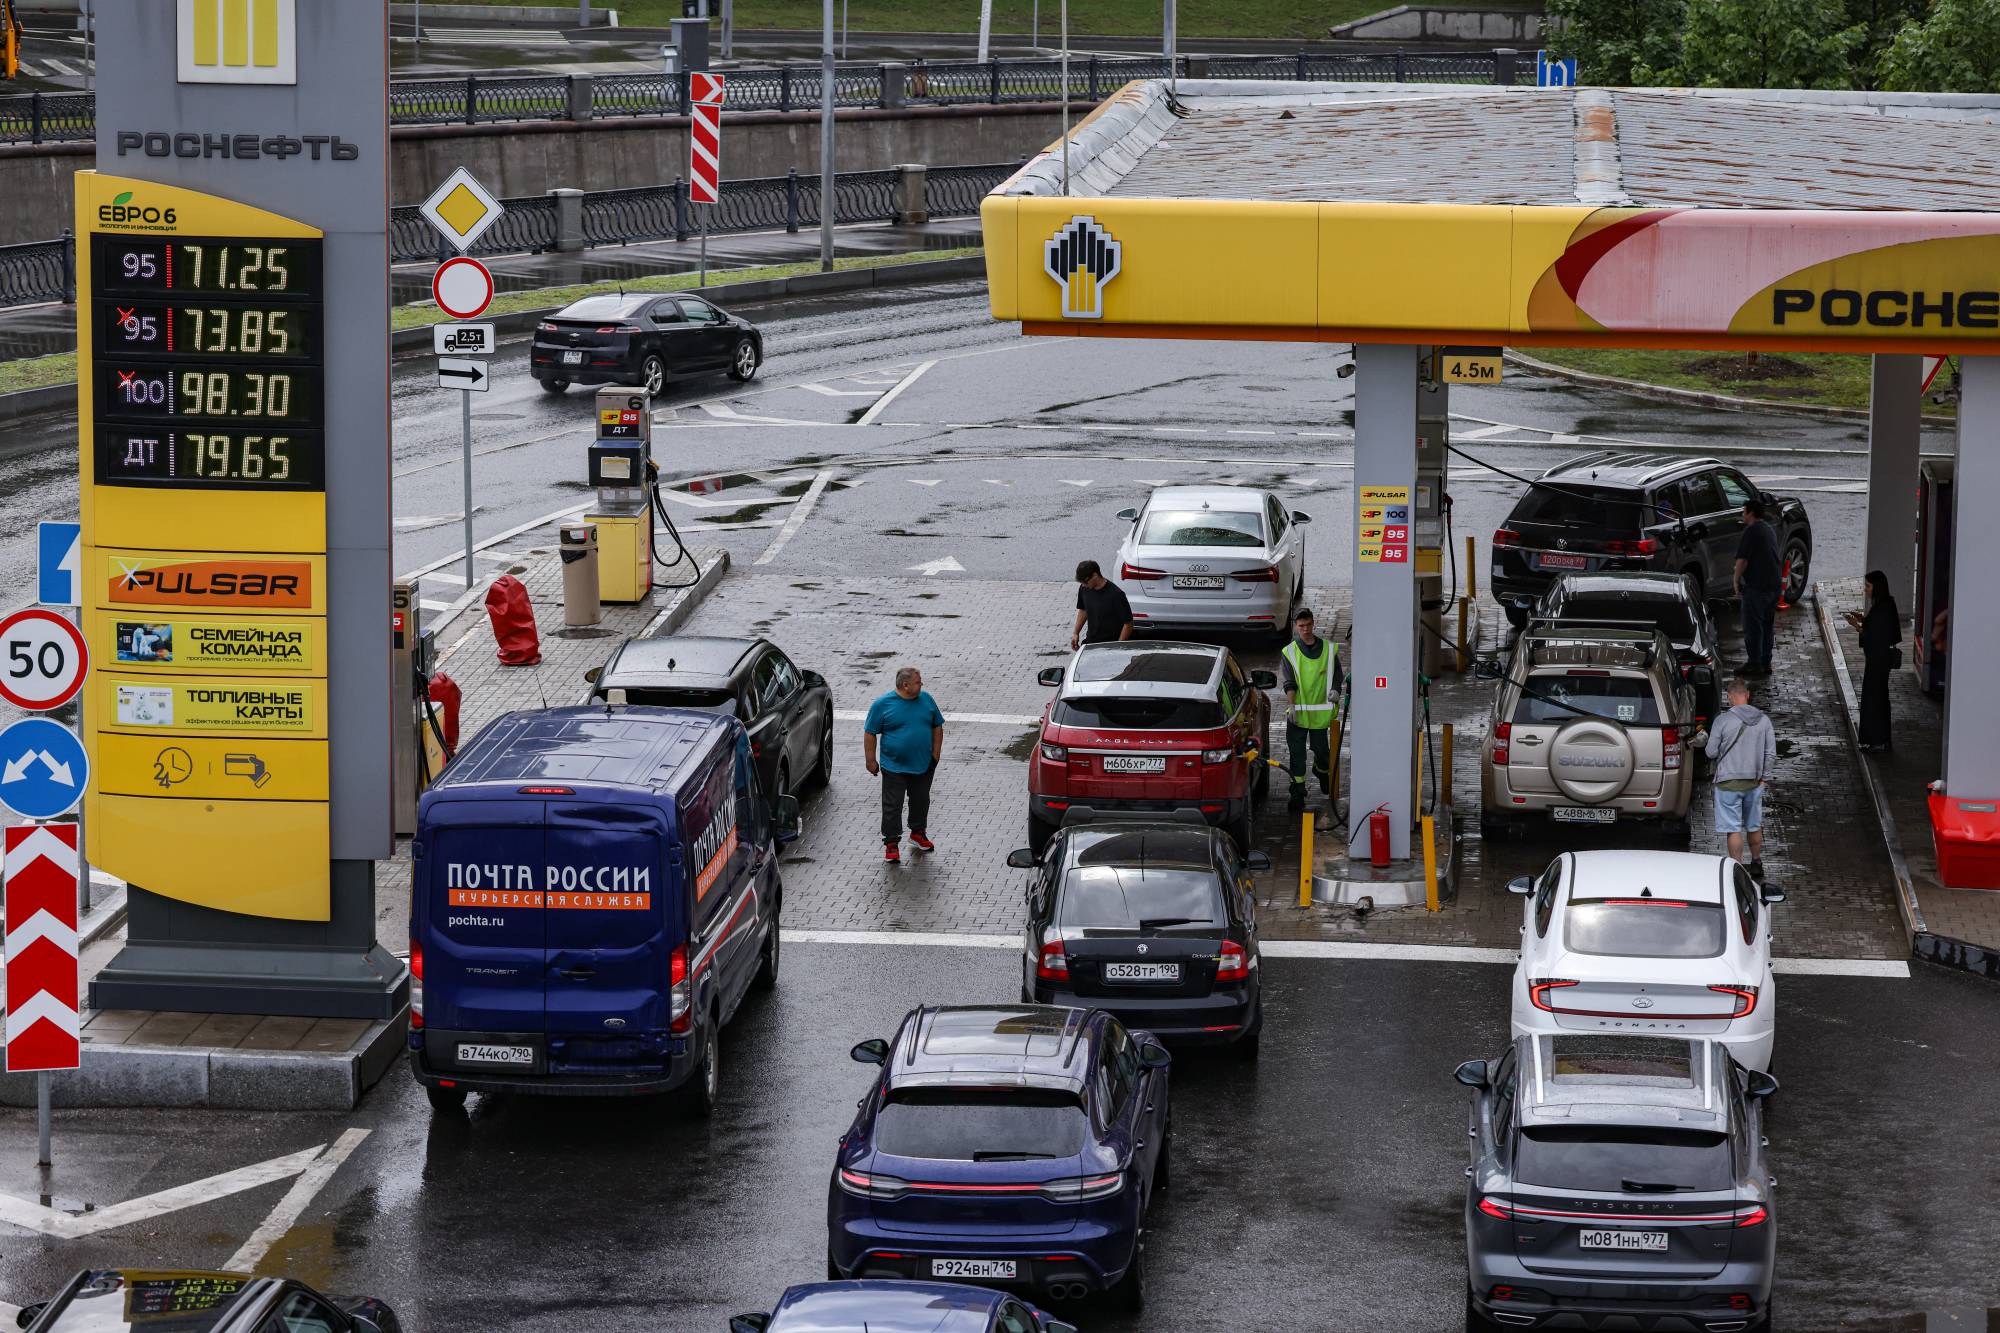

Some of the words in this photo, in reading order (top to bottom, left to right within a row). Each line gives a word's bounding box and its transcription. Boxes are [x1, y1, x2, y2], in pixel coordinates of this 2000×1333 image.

[117, 131, 359, 161] РОСНЕФТЬ
[98, 205, 161, 224] ЕВРО
[163, 208, 177, 224] 6
[123, 252, 156, 278] 95
[184, 245, 288, 290] 71.25
[1773, 289, 2000, 328] РОСНЕ
[124, 315, 157, 341] 95
[184, 309, 288, 353] 73.85
[120, 379, 165, 404] 100
[182, 372, 290, 417] 98.30
[628, 396, 643, 411] 6
[622, 413, 637, 421] 95
[612, 426, 628, 434] ДТ
[124, 438, 159, 467] ДТ
[186, 434, 290, 479] 79.65
[1386, 510, 1406, 519] 100
[1387, 530, 1405, 538] 95
[1384, 549, 1402, 558] 95
[1209, 576, 1222, 584] 790
[190, 628, 302, 643] СЕМЕЙНАЯ
[200, 643, 302, 658] КОМАНДА
[9, 640, 65, 679] 50
[187, 690, 303, 705] ТОПЛИВНЫЕ
[236, 706, 303, 719] КАРТЫ
[1148, 758, 1163, 767] 777
[1558, 755, 1625, 769] SUZUKI
[1599, 808, 1613, 818] 197
[448, 863, 533, 890] ПОЧТА
[546, 866, 650, 892] РОССИИ
[458, 892, 567, 907] КУРЬЕРСКАЯ
[573, 894, 644, 907] СЛУЖБА
[448, 914, 504, 928] pochta.ru
[465, 967, 518, 976] TRANSIT
[1159, 964, 1176, 974] 190
[1599, 1021, 1686, 1029] SONATA
[461, 1046, 509, 1062] В744КО
[510, 1047, 529, 1059] 790
[1583, 1231, 1641, 1248] М081НН
[1643, 1233, 1665, 1245] 977
[936, 1261, 990, 1276] Р924ВН
[992, 1261, 1013, 1273] 716
